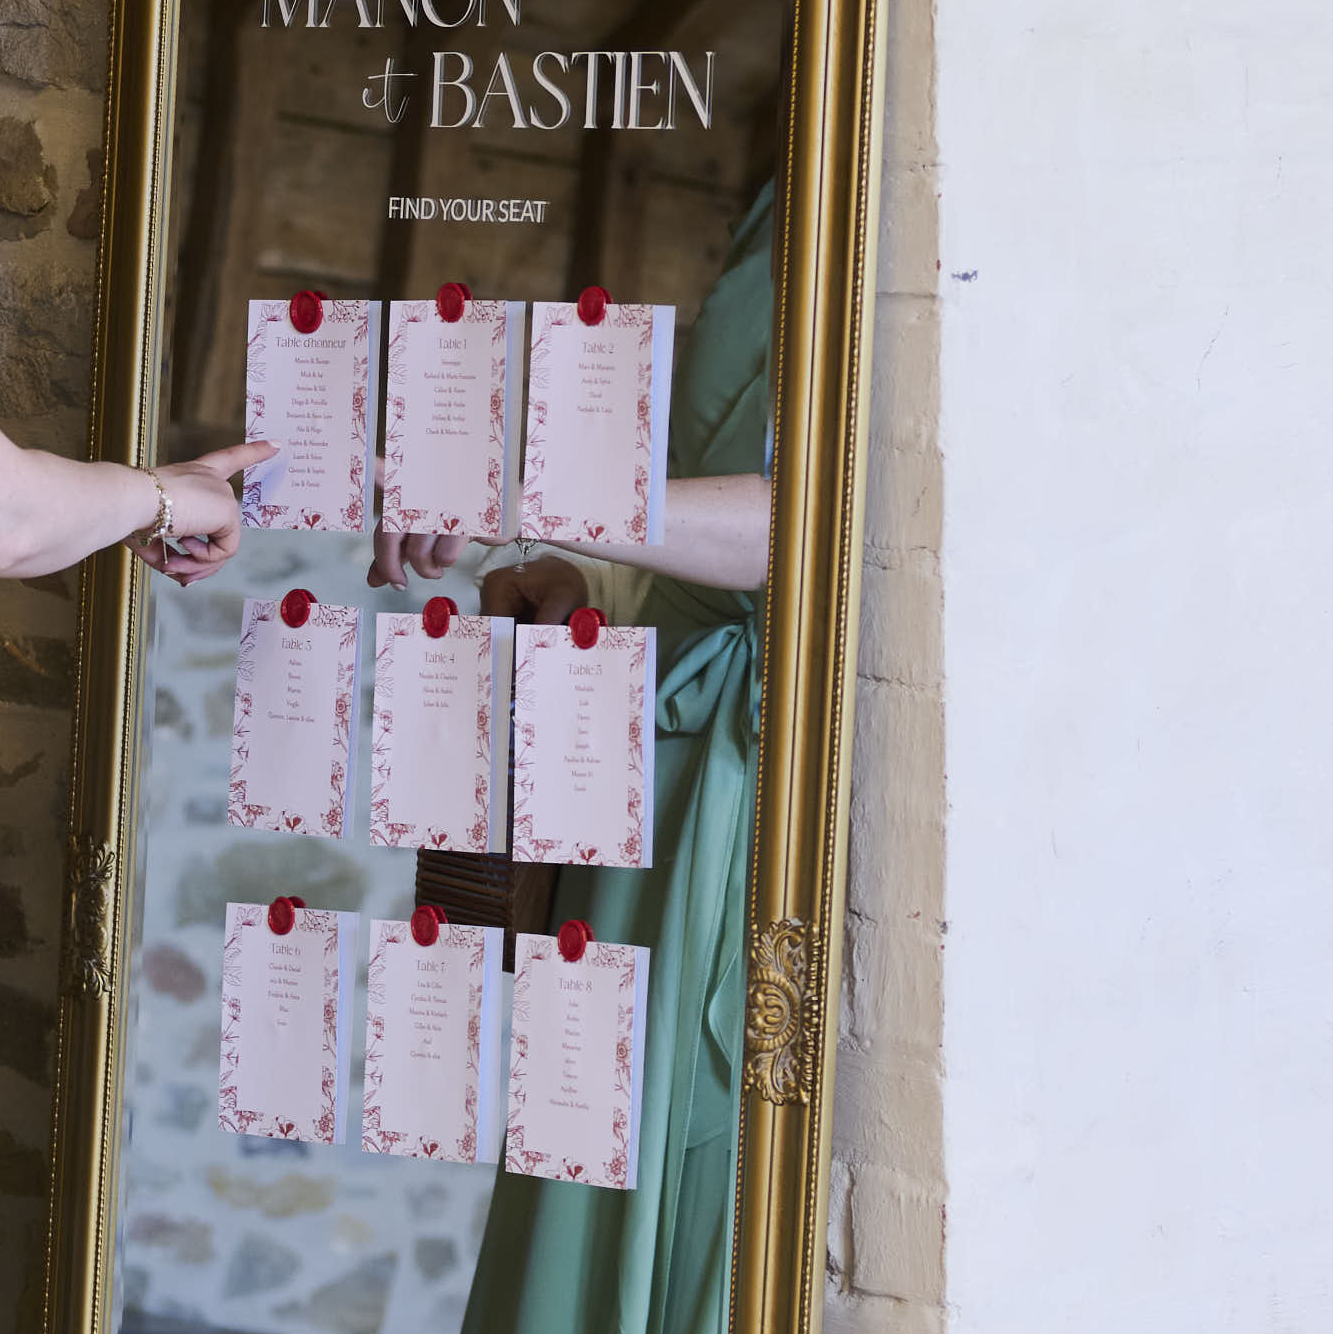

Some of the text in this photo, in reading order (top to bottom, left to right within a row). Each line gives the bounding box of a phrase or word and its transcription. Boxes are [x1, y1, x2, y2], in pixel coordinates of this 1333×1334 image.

[362, 51, 716, 130] et BASTIEN
[388, 196, 550, 224] FIND YOUR SEAT
[275, 336, 301, 348] Table
[437, 338, 462, 349] Table
[581, 341, 607, 354] Table
[281, 637, 303, 651] Table
[424, 651, 447, 664] Table
[568, 663, 593, 676] Table
[271, 942, 293, 956] Table
[416, 959, 439, 972] Table
[558, 977, 583, 992] Table
